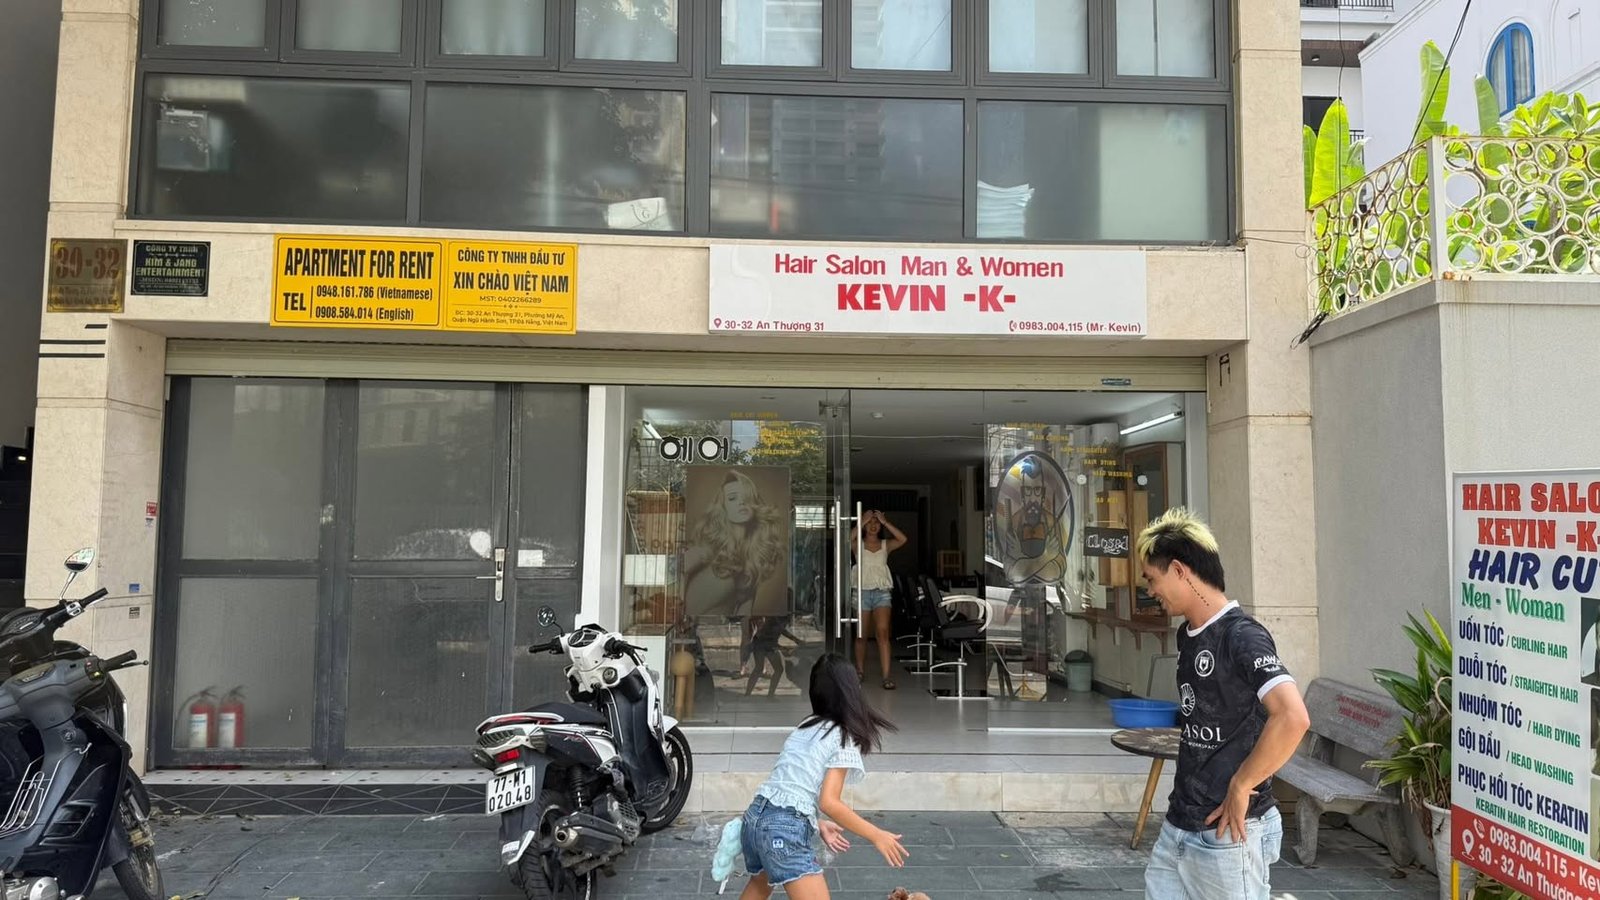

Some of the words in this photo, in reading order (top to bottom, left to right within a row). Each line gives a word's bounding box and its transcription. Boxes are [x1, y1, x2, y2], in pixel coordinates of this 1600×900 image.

[145, 257, 163, 267] KIM
[165, 259, 171, 267] &
[174, 258, 198, 268] JANG
[284, 247, 366, 277] APARTMENT
[370, 250, 395, 279] FOR
[399, 250, 434, 279] RENT
[458, 247, 485, 263] CÔNG
[487, 250, 499, 264] TY
[502, 250, 528, 265] TNHH
[530, 248, 550, 266] ĐẦU
[552, 251, 566, 266] TƯ
[774, 253, 818, 275] Hair
[825, 254, 886, 275] Salon
[901, 255, 947, 276] Man
[956, 256, 974, 276] &
[980, 256, 1064, 278] Women
[136, 267, 206, 277] ENTERTAINMENT
[453, 271, 475, 290] XIN
[478, 269, 510, 291] CHÀO
[513, 270, 538, 295] VIỆT
[541, 275, 569, 293] NAM
[283, 292, 307, 311] TEL
[316, 285, 374, 298] 0948.161.786
[377, 286, 433, 301] (Vietnamese)
[837, 283, 946, 312] KEVIN
[963, 284, 1017, 312] -K-
[315, 306, 373, 320] 0908.584.014
[376, 307, 414, 322] (English)
[724, 320, 753, 330] 30-32
[756, 320, 770, 330] An
[773, 320, 811, 332] Thượng
[814, 321, 825, 331] 31
[1019, 321, 1083, 332] 0983.004.115
[1108, 321, 1141, 333] Kevin)
[1461, 483, 1522, 512] HAIR
[1477, 517, 1557, 550] KEVIN
[1468, 548, 1541, 590] HAIR
[1552, 554, 1600, 594] CU
[1461, 581, 1492, 610] Men
[1505, 587, 1566, 623] Woman
[1459, 614, 1481, 643] UỐN
[1483, 621, 1504, 648] TÓC
[1511, 635, 1546, 655] CURLING
[1547, 643, 1568, 660] HAIR
[1459, 652, 1484, 680] DUỖI
[1486, 659, 1507, 686] TÓC
[1514, 674, 1559, 700] STRAIGHTEN
[1559, 687, 1579, 704] HAIR
[1458, 691, 1498, 722] NHUỘM
[1500, 701, 1522, 729] TÓC
[1532, 720, 1551, 739] HAIR
[1554, 727, 1581, 749] DYING
[1458, 726, 1476, 754] GỘI
[1478, 730, 1501, 760] ĐẦU
[1511, 751, 1532, 771] HEAD
[1534, 759, 1574, 786] WASHING
[493, 770, 527, 794] 77-M1
[488, 785, 532, 812] 020.48
[1457, 763, 1486, 793] PHỤC
[1489, 771, 1508, 801] HỒI
[1510, 782, 1533, 811] TÓC
[1536, 793, 1589, 835] KERATIN
[1475, 796, 1506, 821] KERATIN
[1507, 810, 1527, 829] HAIR
[1527, 819, 1585, 856] RESTORATION
[1478, 843, 1492, 866] 30
[1500, 854, 1515, 878] 32
[1517, 862, 1534, 888] An
[1489, 825, 1569, 879] 0983.004.115
